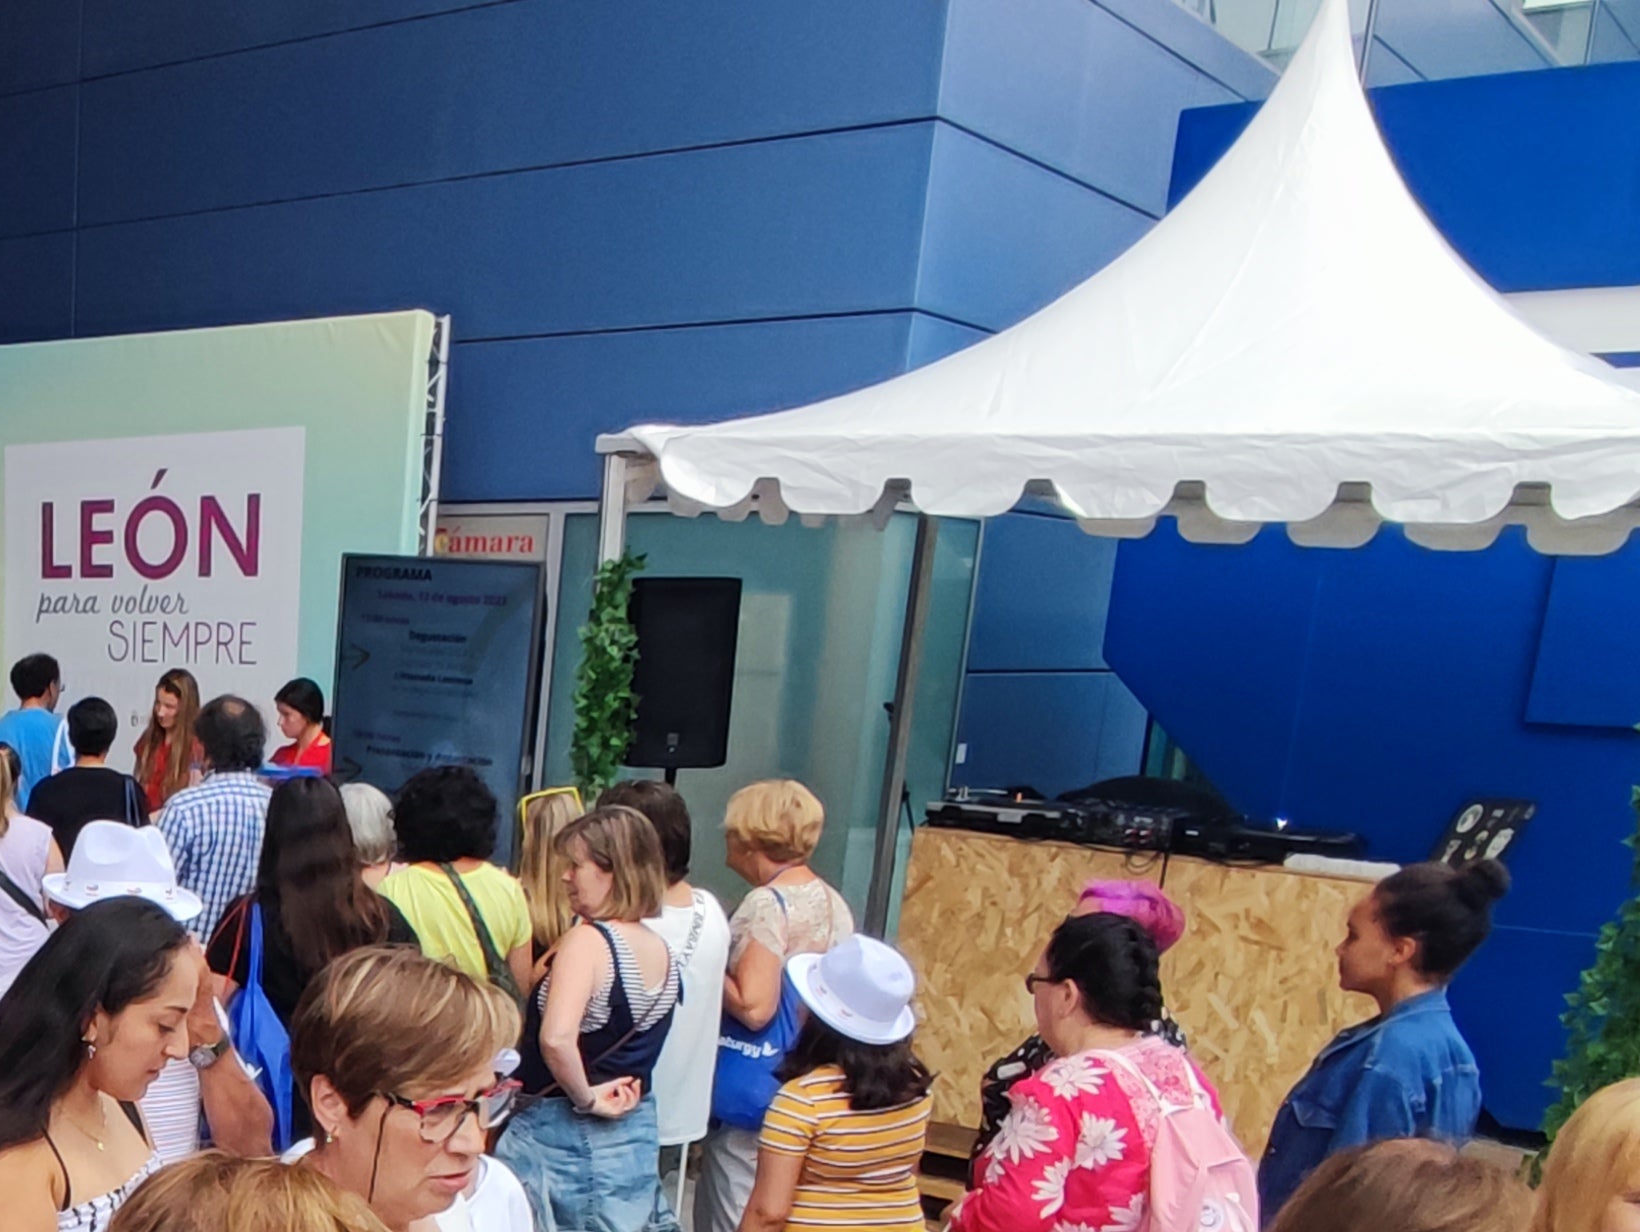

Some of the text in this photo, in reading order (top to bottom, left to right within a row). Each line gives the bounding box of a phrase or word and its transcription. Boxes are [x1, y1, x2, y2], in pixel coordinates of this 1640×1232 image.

[41, 468, 261, 580] LEÓN
[356, 565, 433, 582] PROGRAMA
[36, 584, 189, 624] para volver
[107, 619, 257, 665] SIEMPRE
